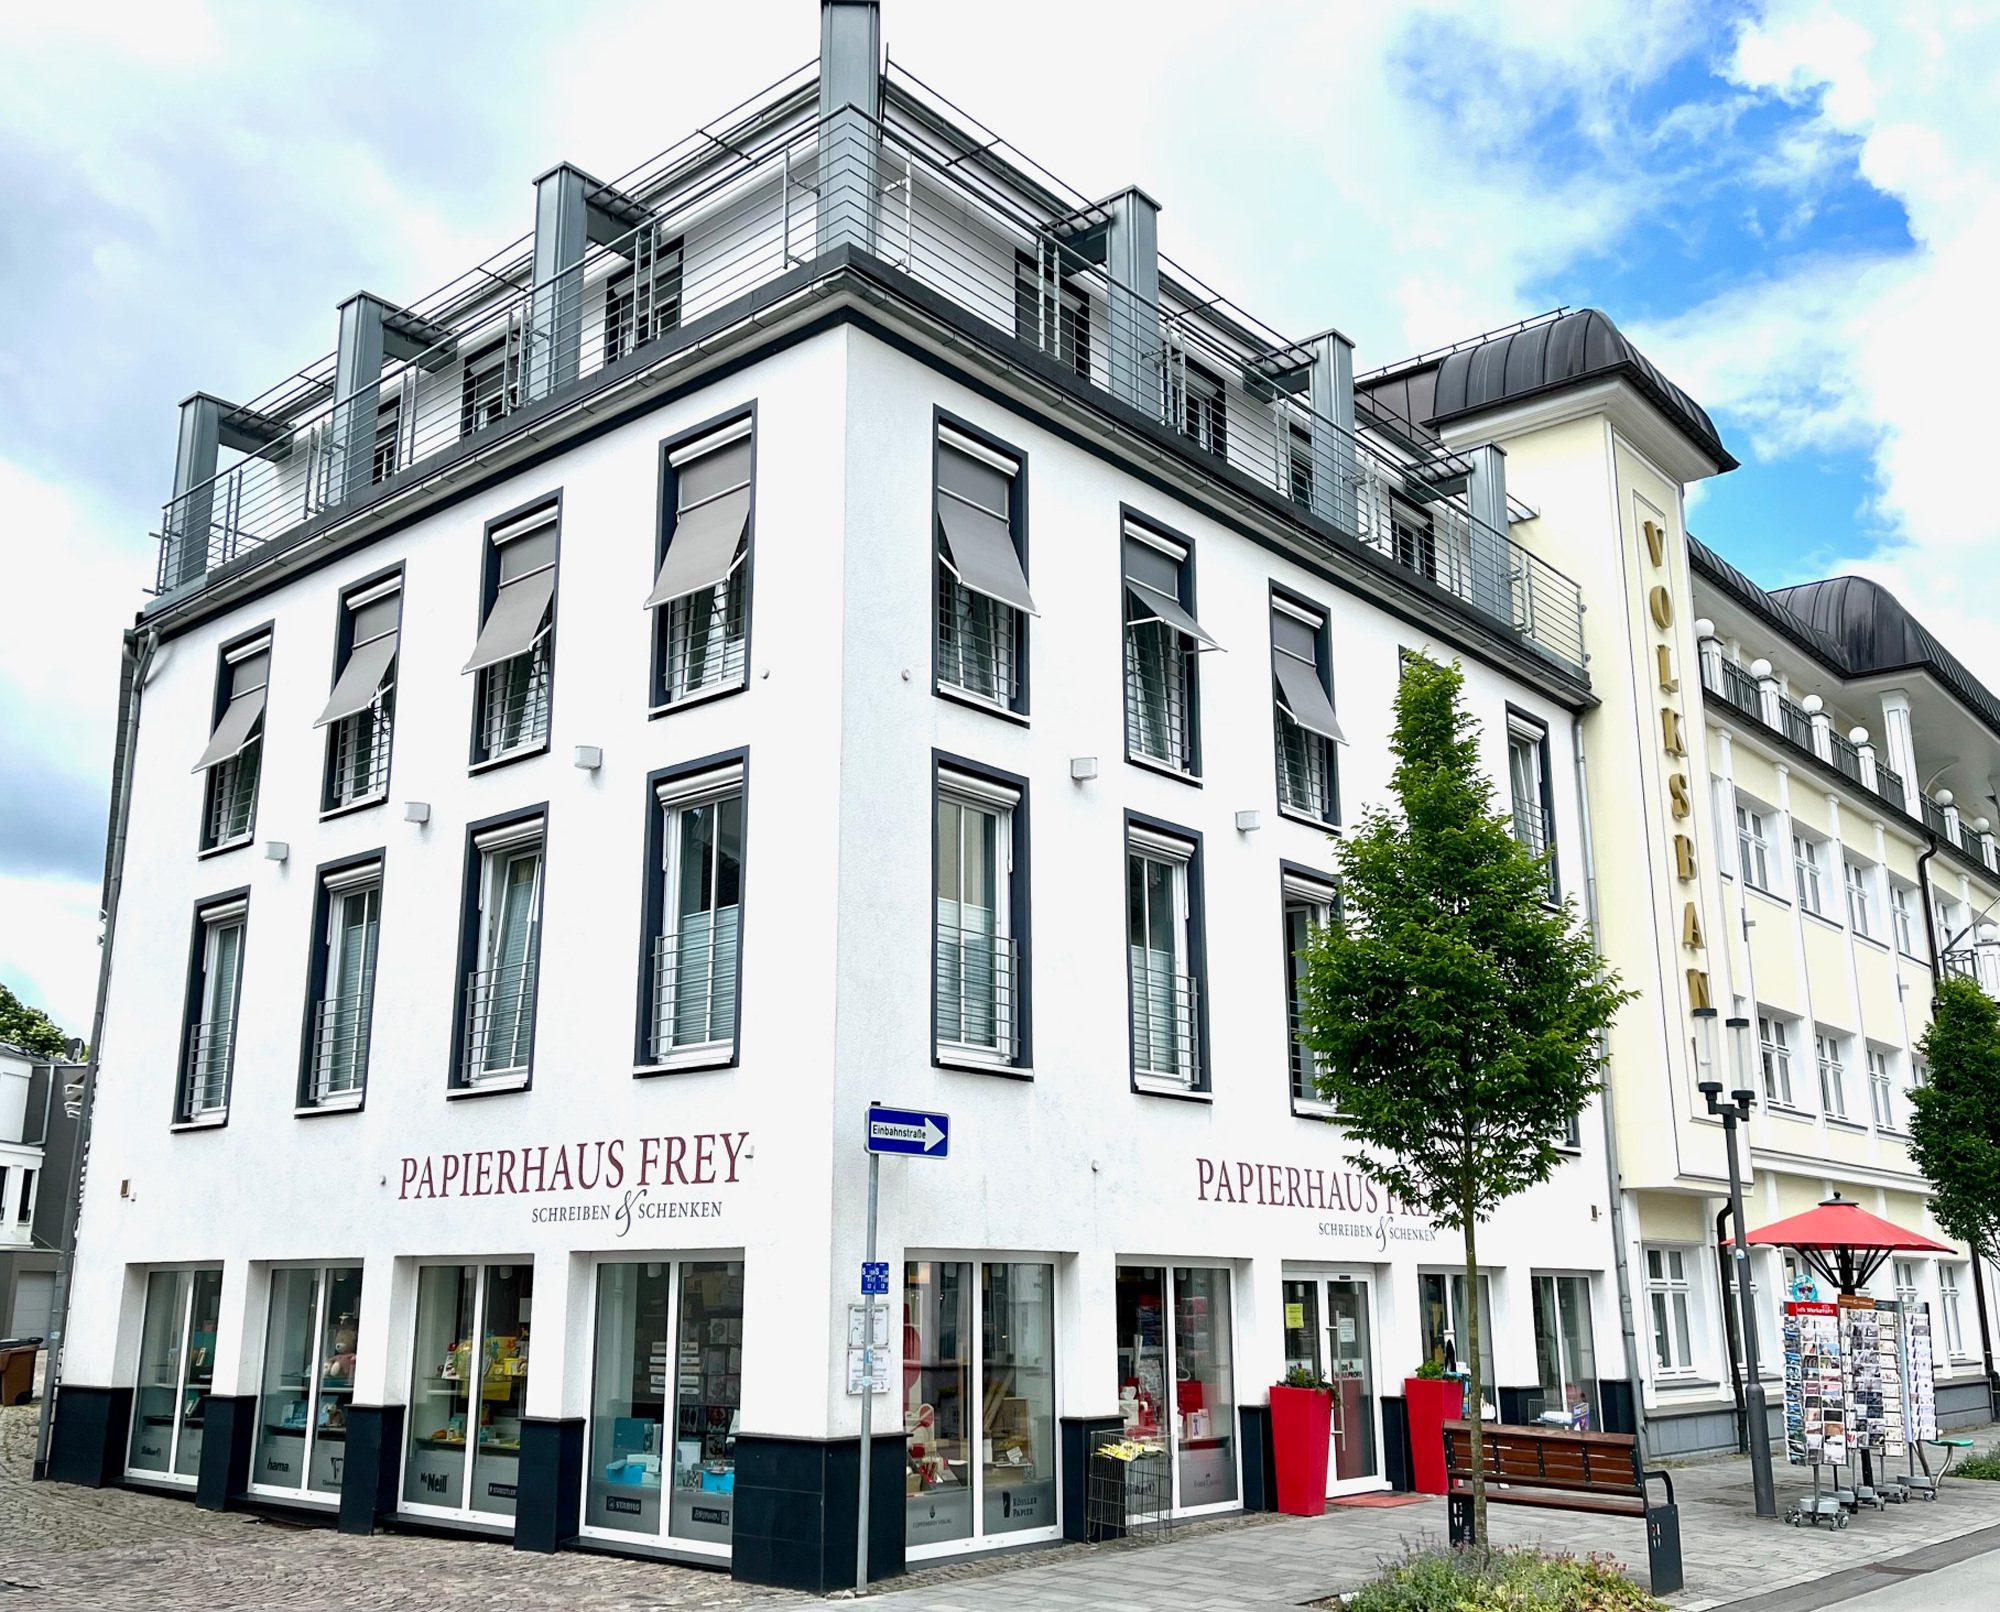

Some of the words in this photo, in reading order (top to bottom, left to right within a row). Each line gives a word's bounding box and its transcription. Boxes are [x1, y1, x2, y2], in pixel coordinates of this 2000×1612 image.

[1643, 519, 1711, 1088] VOLKSBAN
[873, 1124, 926, 1139] Einbahnstraße
[398, 1138, 625, 1200] PAPIERHAUS
[636, 1131, 750, 1187] FREY
[1196, 1158, 1378, 1213] PAPIERHAUS
[1386, 1177, 1446, 1218] FE
[531, 1204, 611, 1223] SCHREIBEN
[615, 1189, 648, 1238] &
[637, 1201, 723, 1220] SCHENKEN
[1318, 1222, 1373, 1238] SCHREIBEN
[1375, 1215, 1394, 1252] &
[1389, 1226, 1436, 1242] SCHENKEN
[267, 1456, 290, 1472] hama
